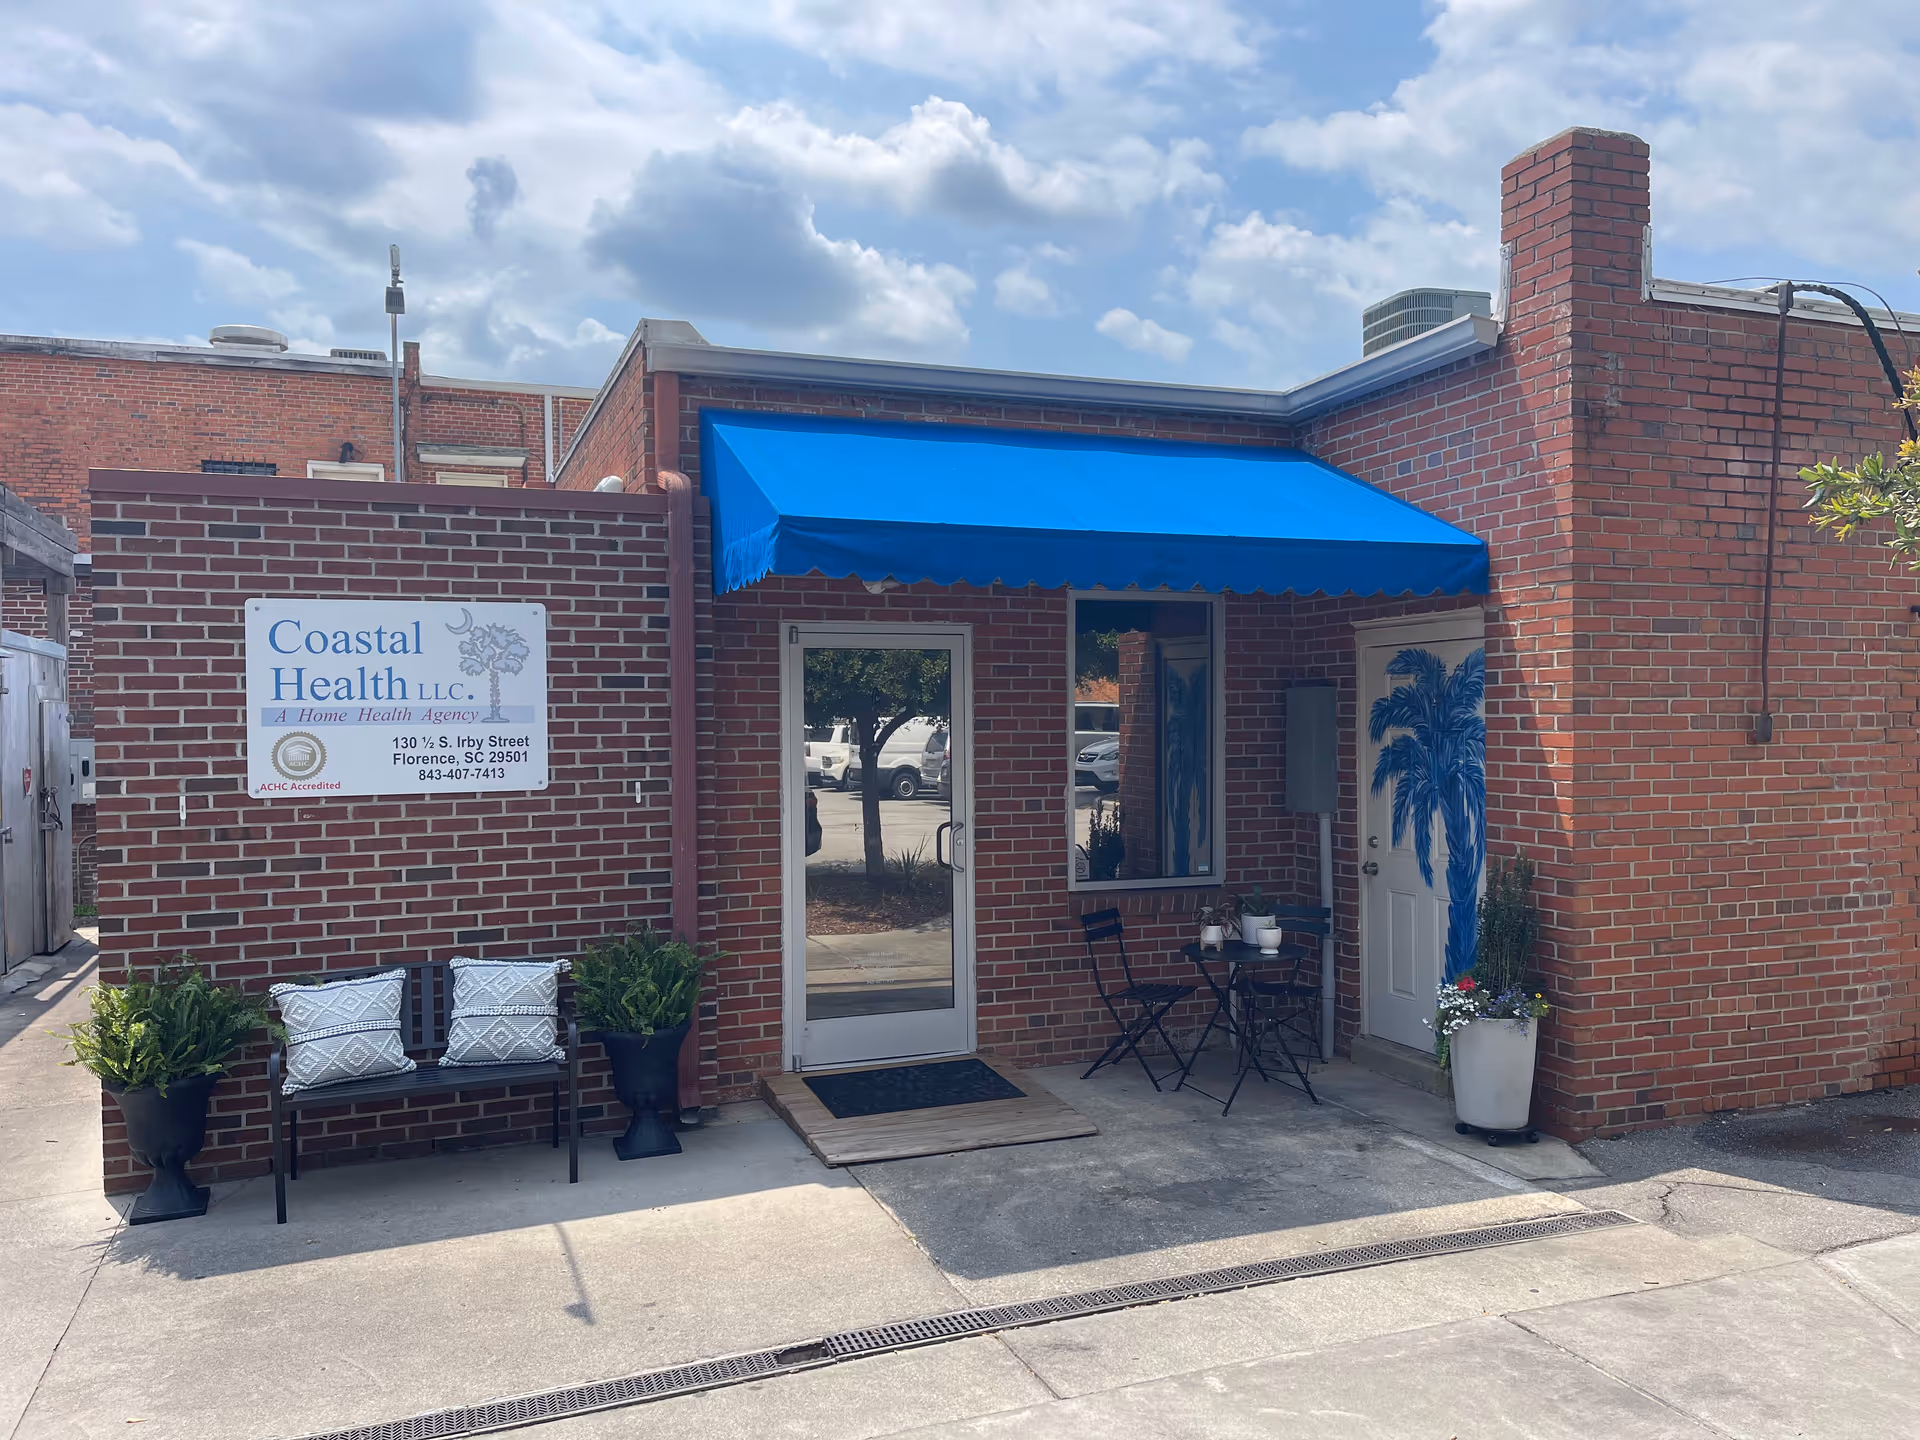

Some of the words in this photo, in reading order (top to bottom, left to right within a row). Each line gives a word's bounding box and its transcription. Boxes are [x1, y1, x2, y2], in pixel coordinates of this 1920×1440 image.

[268, 619, 424, 655] Coastal
[270, 666, 409, 701] Health
[274, 708, 287, 723] A
[299, 708, 348, 722] Home
[358, 707, 412, 722] Health
[421, 707, 479, 725] Agency
[392, 736, 417, 750] 130
[438, 735, 453, 749] S.
[457, 735, 483, 751] Irby
[488, 734, 530, 748] Street
[392, 751, 460, 767] Florence,
[464, 751, 485, 765] SC
[488, 750, 529, 764] 29501
[418, 767, 505, 781] 843-407-7413
[260, 782, 288, 792] ACHC
[290, 781, 341, 791] Accredited
